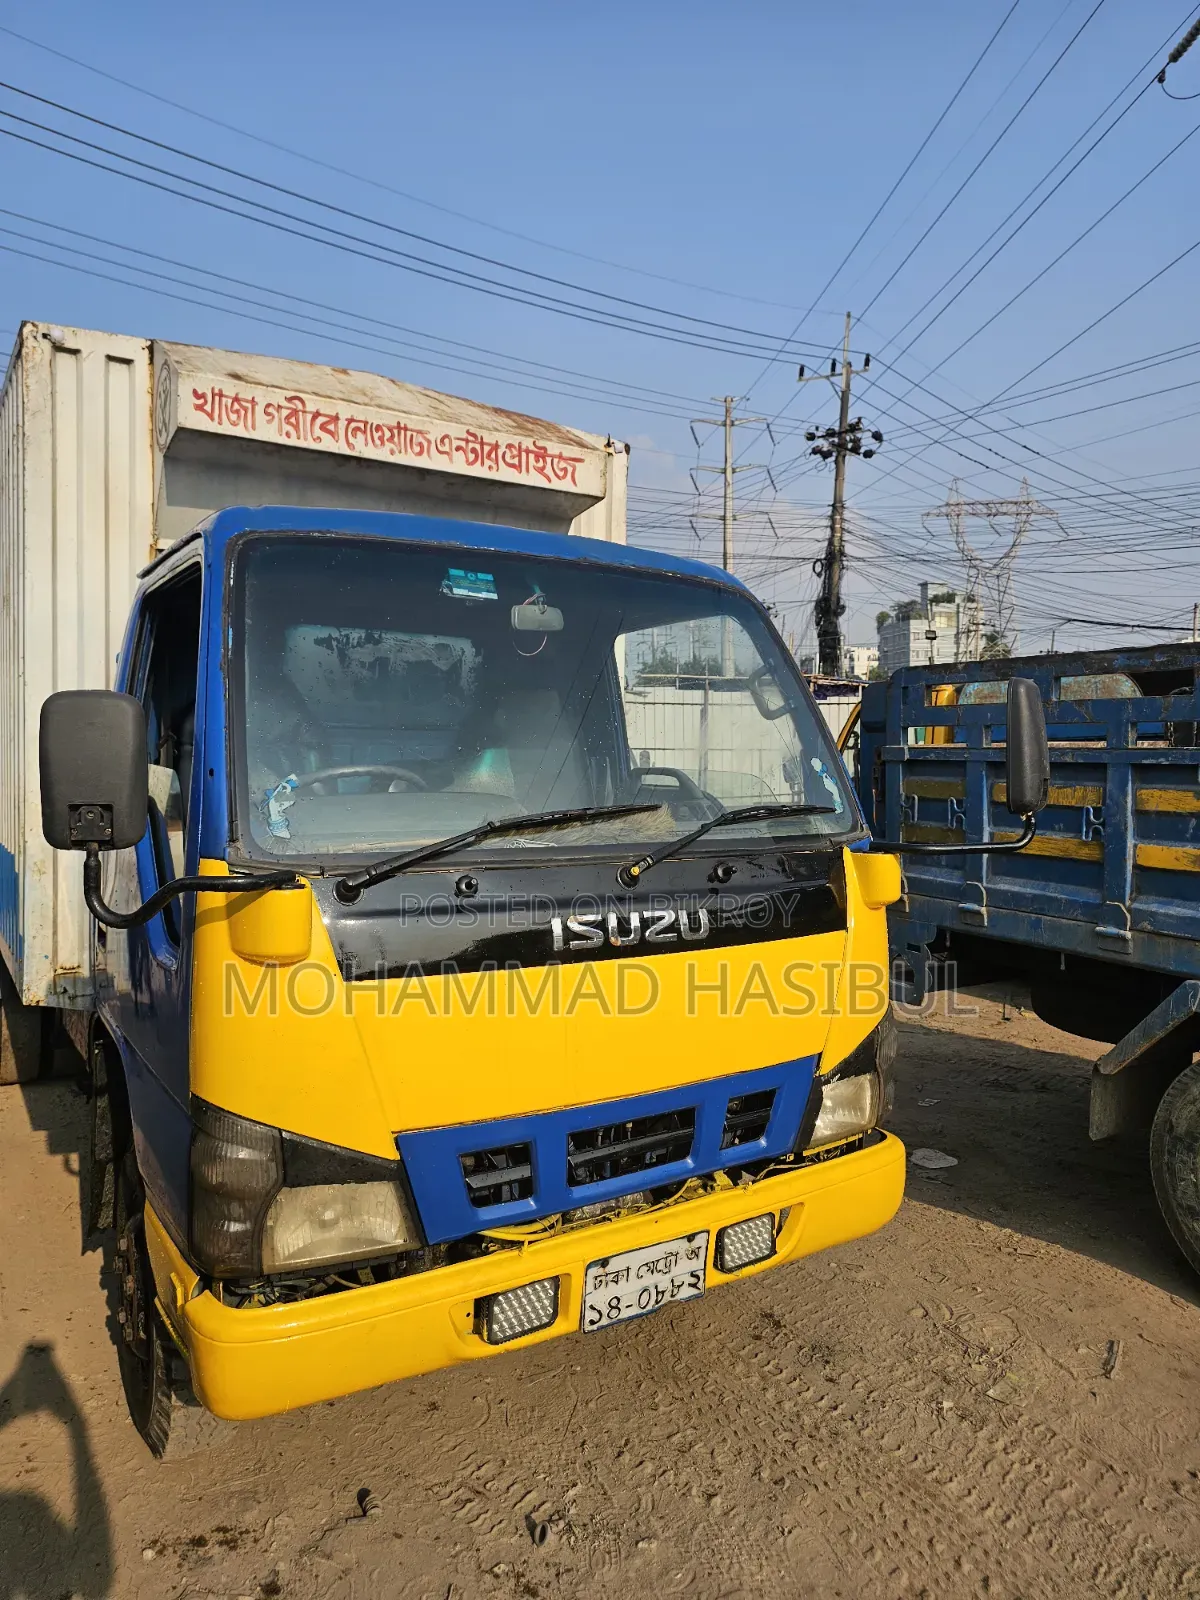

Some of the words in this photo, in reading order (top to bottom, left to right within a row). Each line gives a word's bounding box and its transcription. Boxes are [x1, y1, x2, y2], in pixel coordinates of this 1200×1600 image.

[192, 386, 258, 432] খাজা
[264, 395, 341, 441] গরীবে
[344, 414, 432, 462] নেওয়াজ
[551, 908, 710, 951] ISUZU
[588, 1271, 702, 1326] ১৪-০৮৮২
[593, 1265, 632, 1290] ঢাকা
